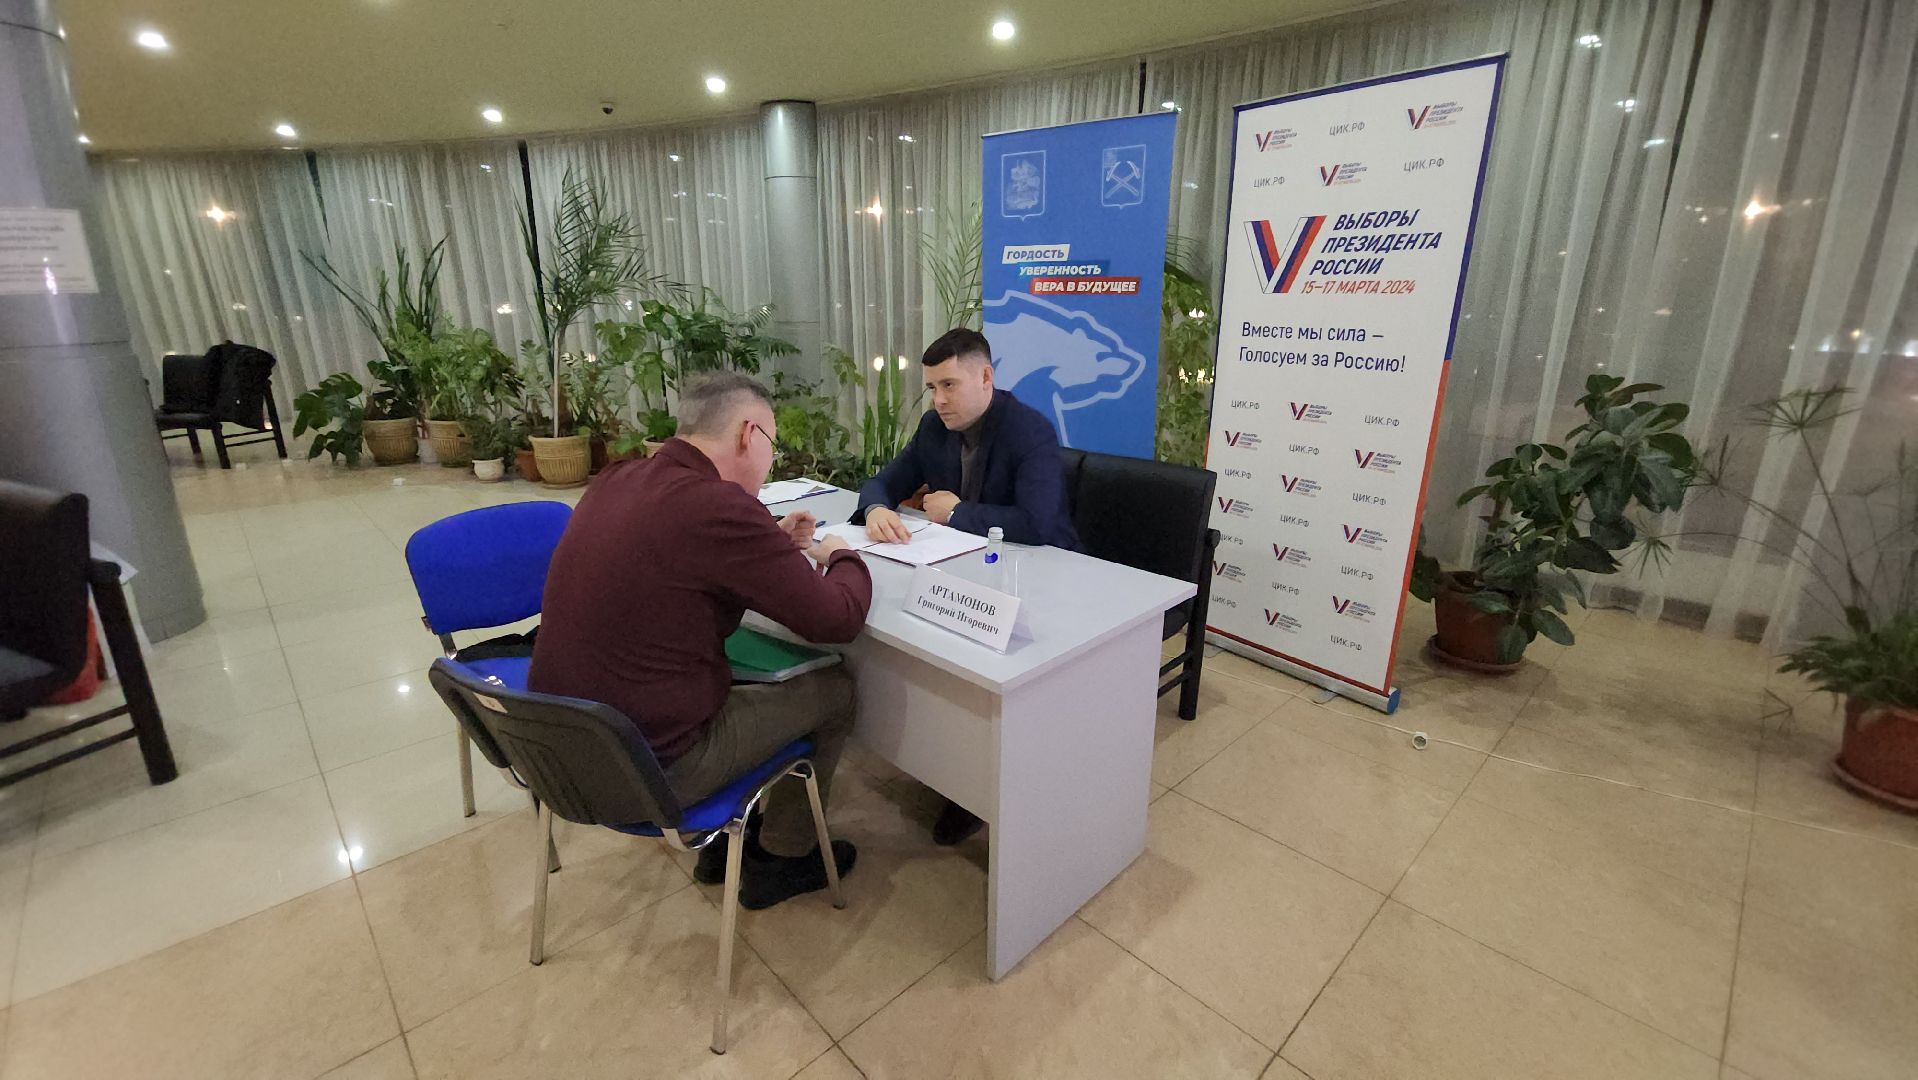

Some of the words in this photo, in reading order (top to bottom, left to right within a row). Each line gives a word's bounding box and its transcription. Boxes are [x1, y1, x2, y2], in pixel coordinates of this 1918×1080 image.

[1329, 122, 1365, 136] ЦИК.РФ
[1404, 157, 1444, 172] ЦИК.РФ
[1254, 176, 1285, 188] ЦИК.РФ
[1333, 208, 1420, 231] ВЫБОРЫ
[1321, 231, 1442, 254] ПРЕЗИДЕНТА
[1007, 249, 1065, 260] ГОРДОСТЬ
[1019, 264, 1102, 277] УВЕРЕННОСТЬ
[1309, 257, 1384, 275] РОССИИ
[1034, 281, 1065, 293] ВЕРА
[1067, 281, 1077, 292] В
[1078, 281, 1137, 294] БУДУЩЕЕ
[1335, 280, 1381, 294] МАРТА
[1380, 279, 1416, 294] 2024
[1242, 321, 1293, 339] Вместе
[1298, 327, 1323, 340] мы
[1327, 326, 1366, 342] сила
[1239, 346, 1307, 368] Голосуем
[1311, 353, 1329, 367] за
[1334, 351, 1406, 373] Россию!
[1231, 399, 1260, 410] ЦИК.РФ
[1364, 415, 1400, 427] ЦИК.РФ
[1289, 443, 1320, 455] ЦИК.РФ
[1224, 468, 1252, 480] ЦИК.РФ
[1352, 492, 1387, 506] ЦИК.РФ
[1280, 514, 1310, 527] ЦИК.РФ
[1340, 565, 1374, 581] ЦИК.РФ
[1271, 581, 1300, 596] ЦИК.РФ
[929, 584, 996, 616] АРТАМОНОВ
[1211, 594, 1237, 608] ЦИК.РФ
[917, 595, 956, 618] Григорий
[957, 610, 999, 635] Игоревич
[1330, 635, 1362, 651] ЦИК.РФ
